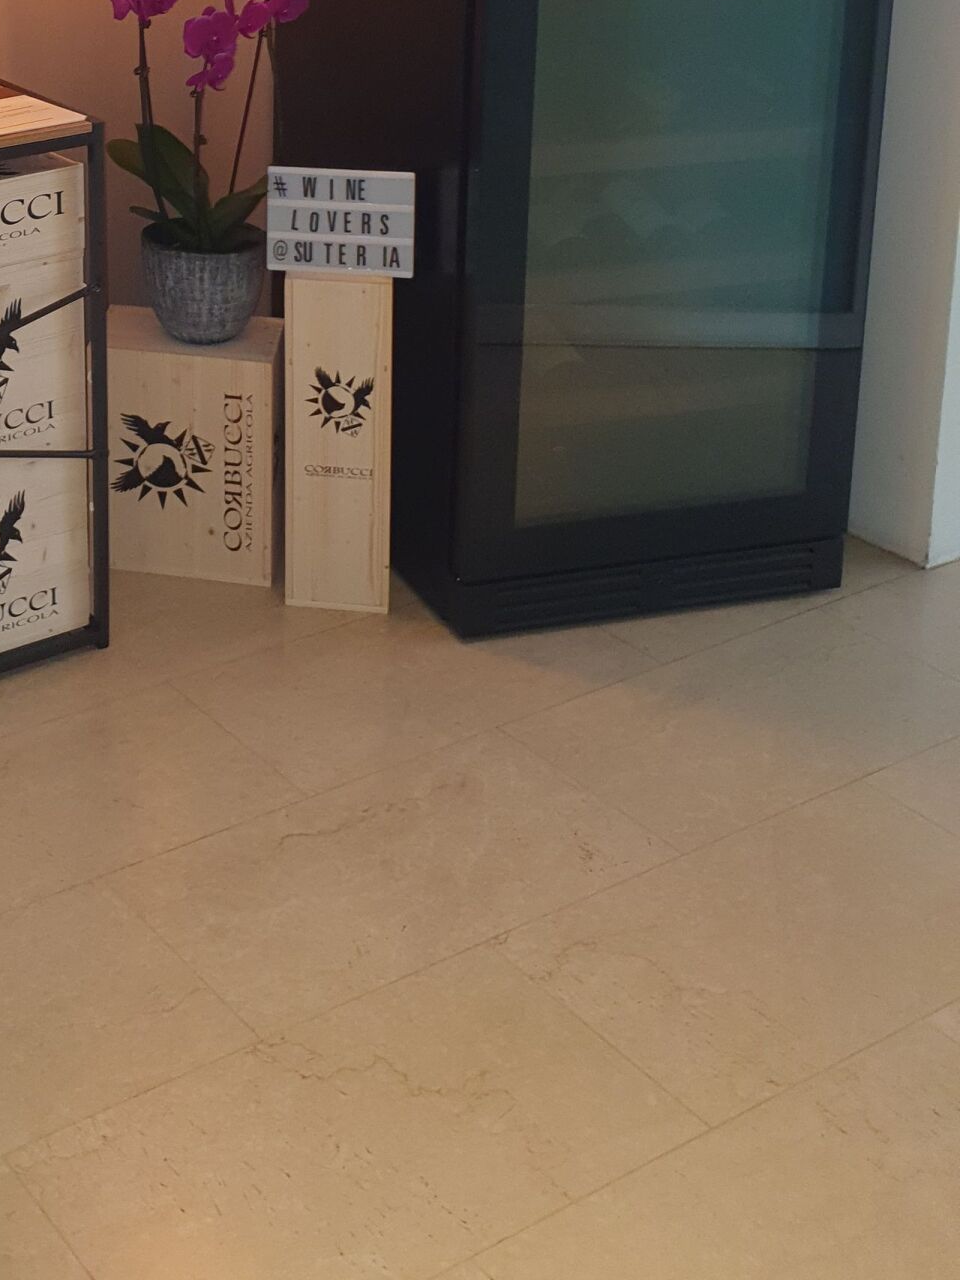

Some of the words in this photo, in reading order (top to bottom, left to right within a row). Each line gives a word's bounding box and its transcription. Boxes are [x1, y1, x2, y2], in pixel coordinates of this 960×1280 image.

[291, 209, 390, 235] LOVERS
[245, 393, 253, 478] AGRICOLA
[244, 482, 253, 552] AZIENDA
